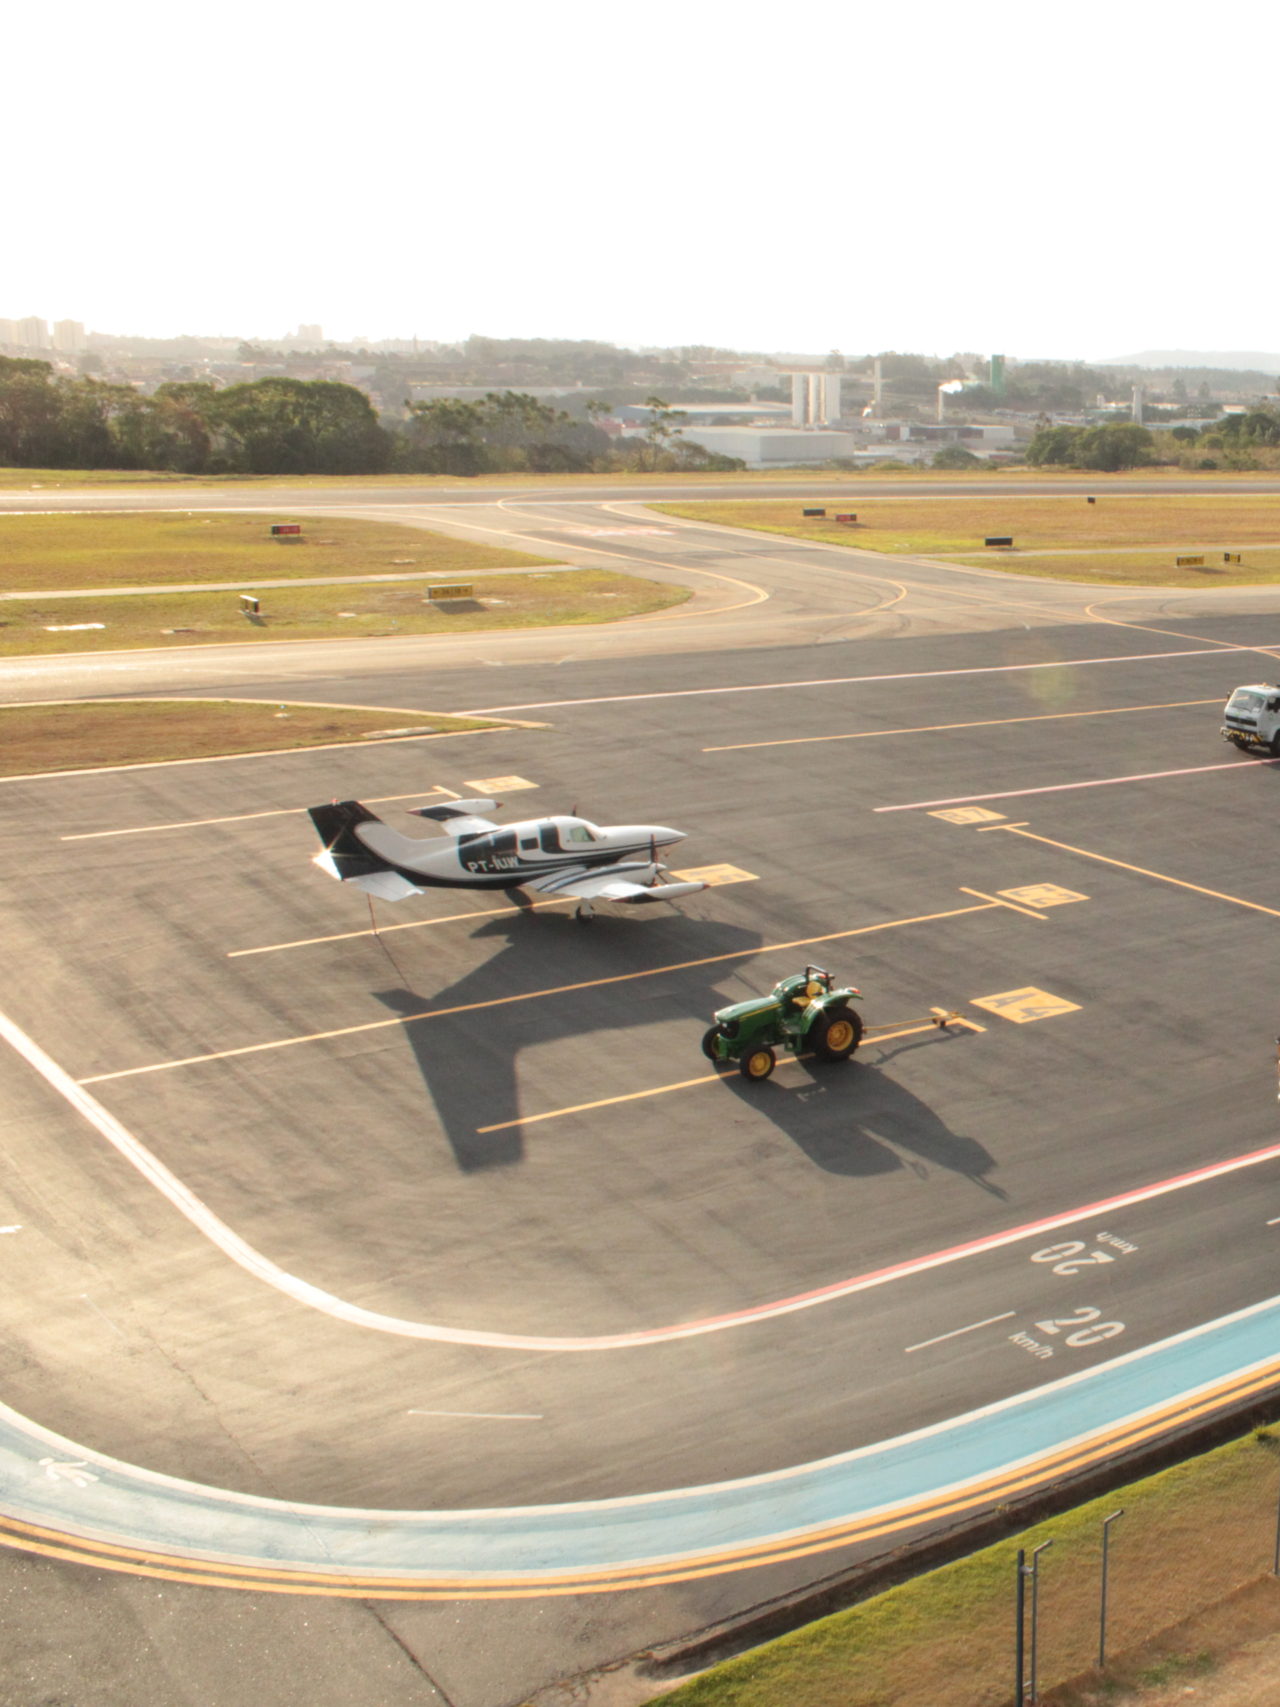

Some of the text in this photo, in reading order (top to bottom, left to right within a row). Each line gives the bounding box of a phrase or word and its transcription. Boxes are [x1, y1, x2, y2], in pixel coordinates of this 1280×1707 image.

[984, 992, 1068, 1019] A4
[1030, 1240, 1116, 1276] 20
[1096, 1231, 1139, 1255] km/h
[1033, 1306, 1126, 1347] 20
[1007, 1330, 1054, 1360] km/h
